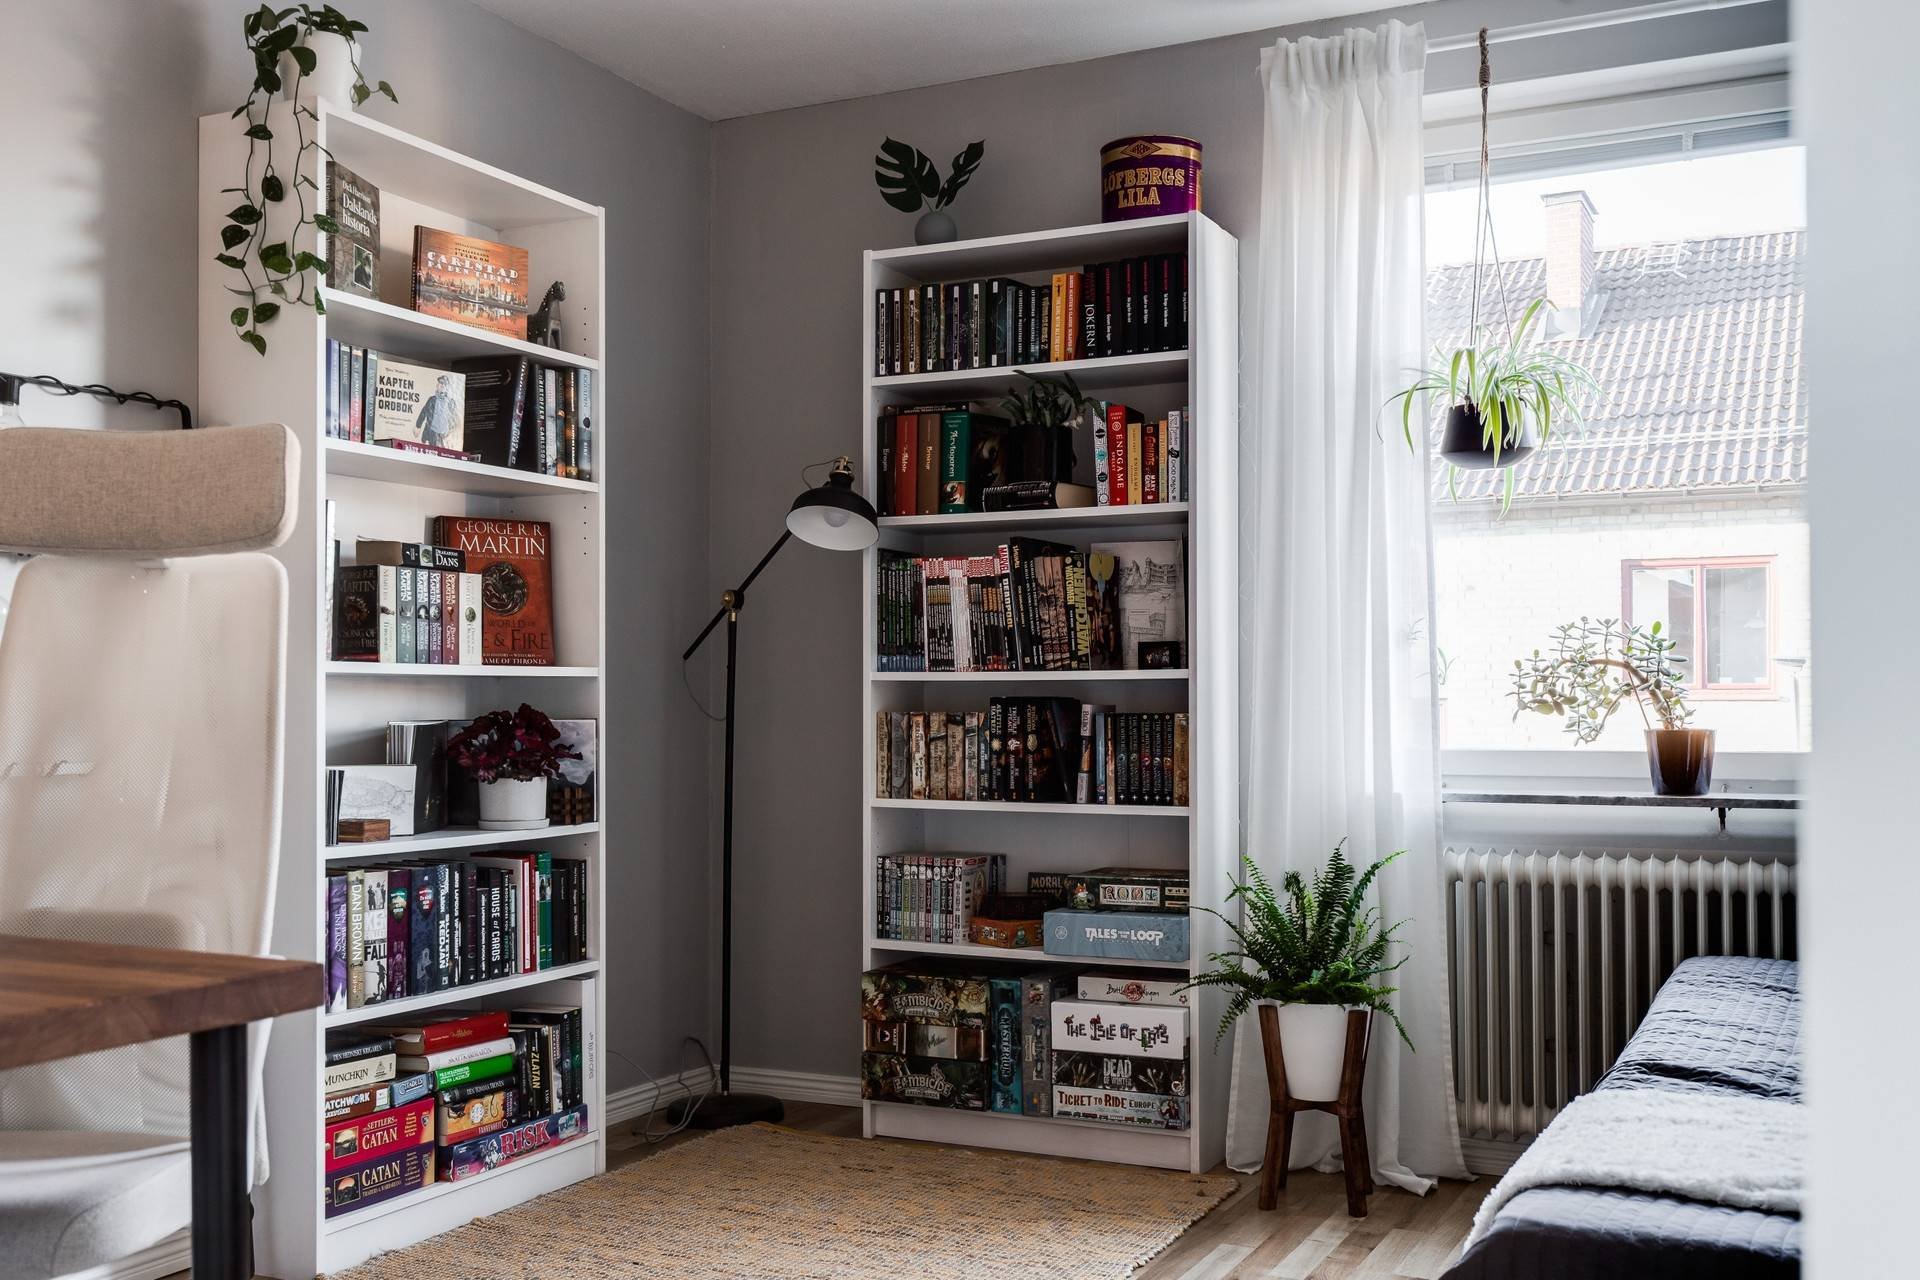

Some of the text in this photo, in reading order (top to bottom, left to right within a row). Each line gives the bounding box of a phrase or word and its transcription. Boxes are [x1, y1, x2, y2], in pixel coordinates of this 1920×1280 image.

[1104, 168, 1184, 194] LÖFBERGS
[343, 193, 377, 225] Dalslands
[1118, 187, 1160, 208] LILA
[342, 208, 370, 237] historia
[427, 252, 518, 278] CARLSTAD
[1085, 304, 1095, 346] JOKERN
[380, 375, 414, 390] KAPTEN
[378, 400, 413, 414] ORDBOK
[949, 430, 958, 477] Arvtagaren
[456, 520, 513, 535] GEORGE
[460, 534, 545, 555] MARTIN
[436, 554, 459, 567] DANS
[999, 546, 1009, 573] MARVEL
[1065, 566, 1074, 604] WATCHMEN
[1003, 578, 1013, 630] DEADPOOL
[1074, 568, 1089, 656] WATCHMEN
[512, 629, 549, 650] FIRE
[1031, 876, 1062, 888] MORAL
[1101, 886, 1158, 901] ROOT
[352, 884, 362, 911] DAN
[492, 888, 500, 918] HOUSE
[352, 913, 362, 961] BROWN
[491, 931, 500, 962] CARDS
[1085, 928, 1118, 942] TALES
[1131, 930, 1164, 946] LOOP
[364, 943, 386, 961] FALL
[892, 995, 951, 1014] ZOMBICIDE
[1065, 1019, 1169, 1048] THE ISLE OF CATS
[1000, 1016, 1012, 1078] MYSTERIUM
[325, 1068, 368, 1086] MUNCHKIN
[532, 1053, 540, 1089] ZLATAN
[1104, 1058, 1132, 1078] DEAD
[894, 1076, 951, 1096] ZOMBICIDE
[325, 1092, 370, 1110] ATCHWORK
[1058, 1091, 1156, 1109] TICKET TO RIDE EUROPE
[366, 1116, 395, 1130] SETTLERS
[362, 1128, 398, 1150] CATAN
[500, 1119, 551, 1156] RISK
[362, 1160, 400, 1186] CATAN
